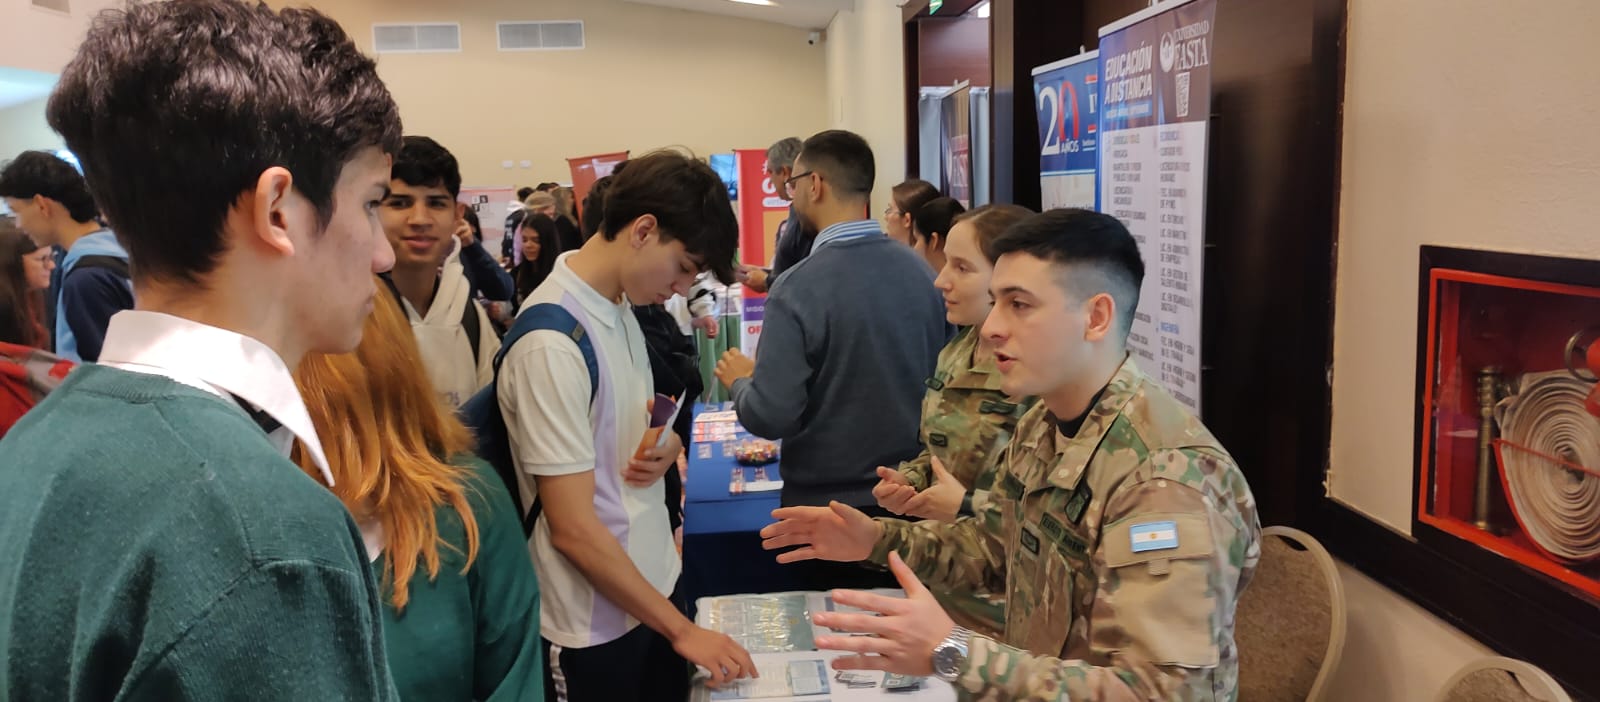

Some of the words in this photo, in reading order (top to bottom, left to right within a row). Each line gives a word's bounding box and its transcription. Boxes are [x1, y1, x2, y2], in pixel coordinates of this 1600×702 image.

[1173, 19, 1210, 40] UNIVERSIDAD
[1105, 40, 1153, 81] EDUCACIÓN
[1174, 36, 1209, 70] FASTA
[1104, 82, 1111, 105] A
[1111, 73, 1153, 103] DISTANCIA
[1061, 138, 1080, 154] AÑOS
